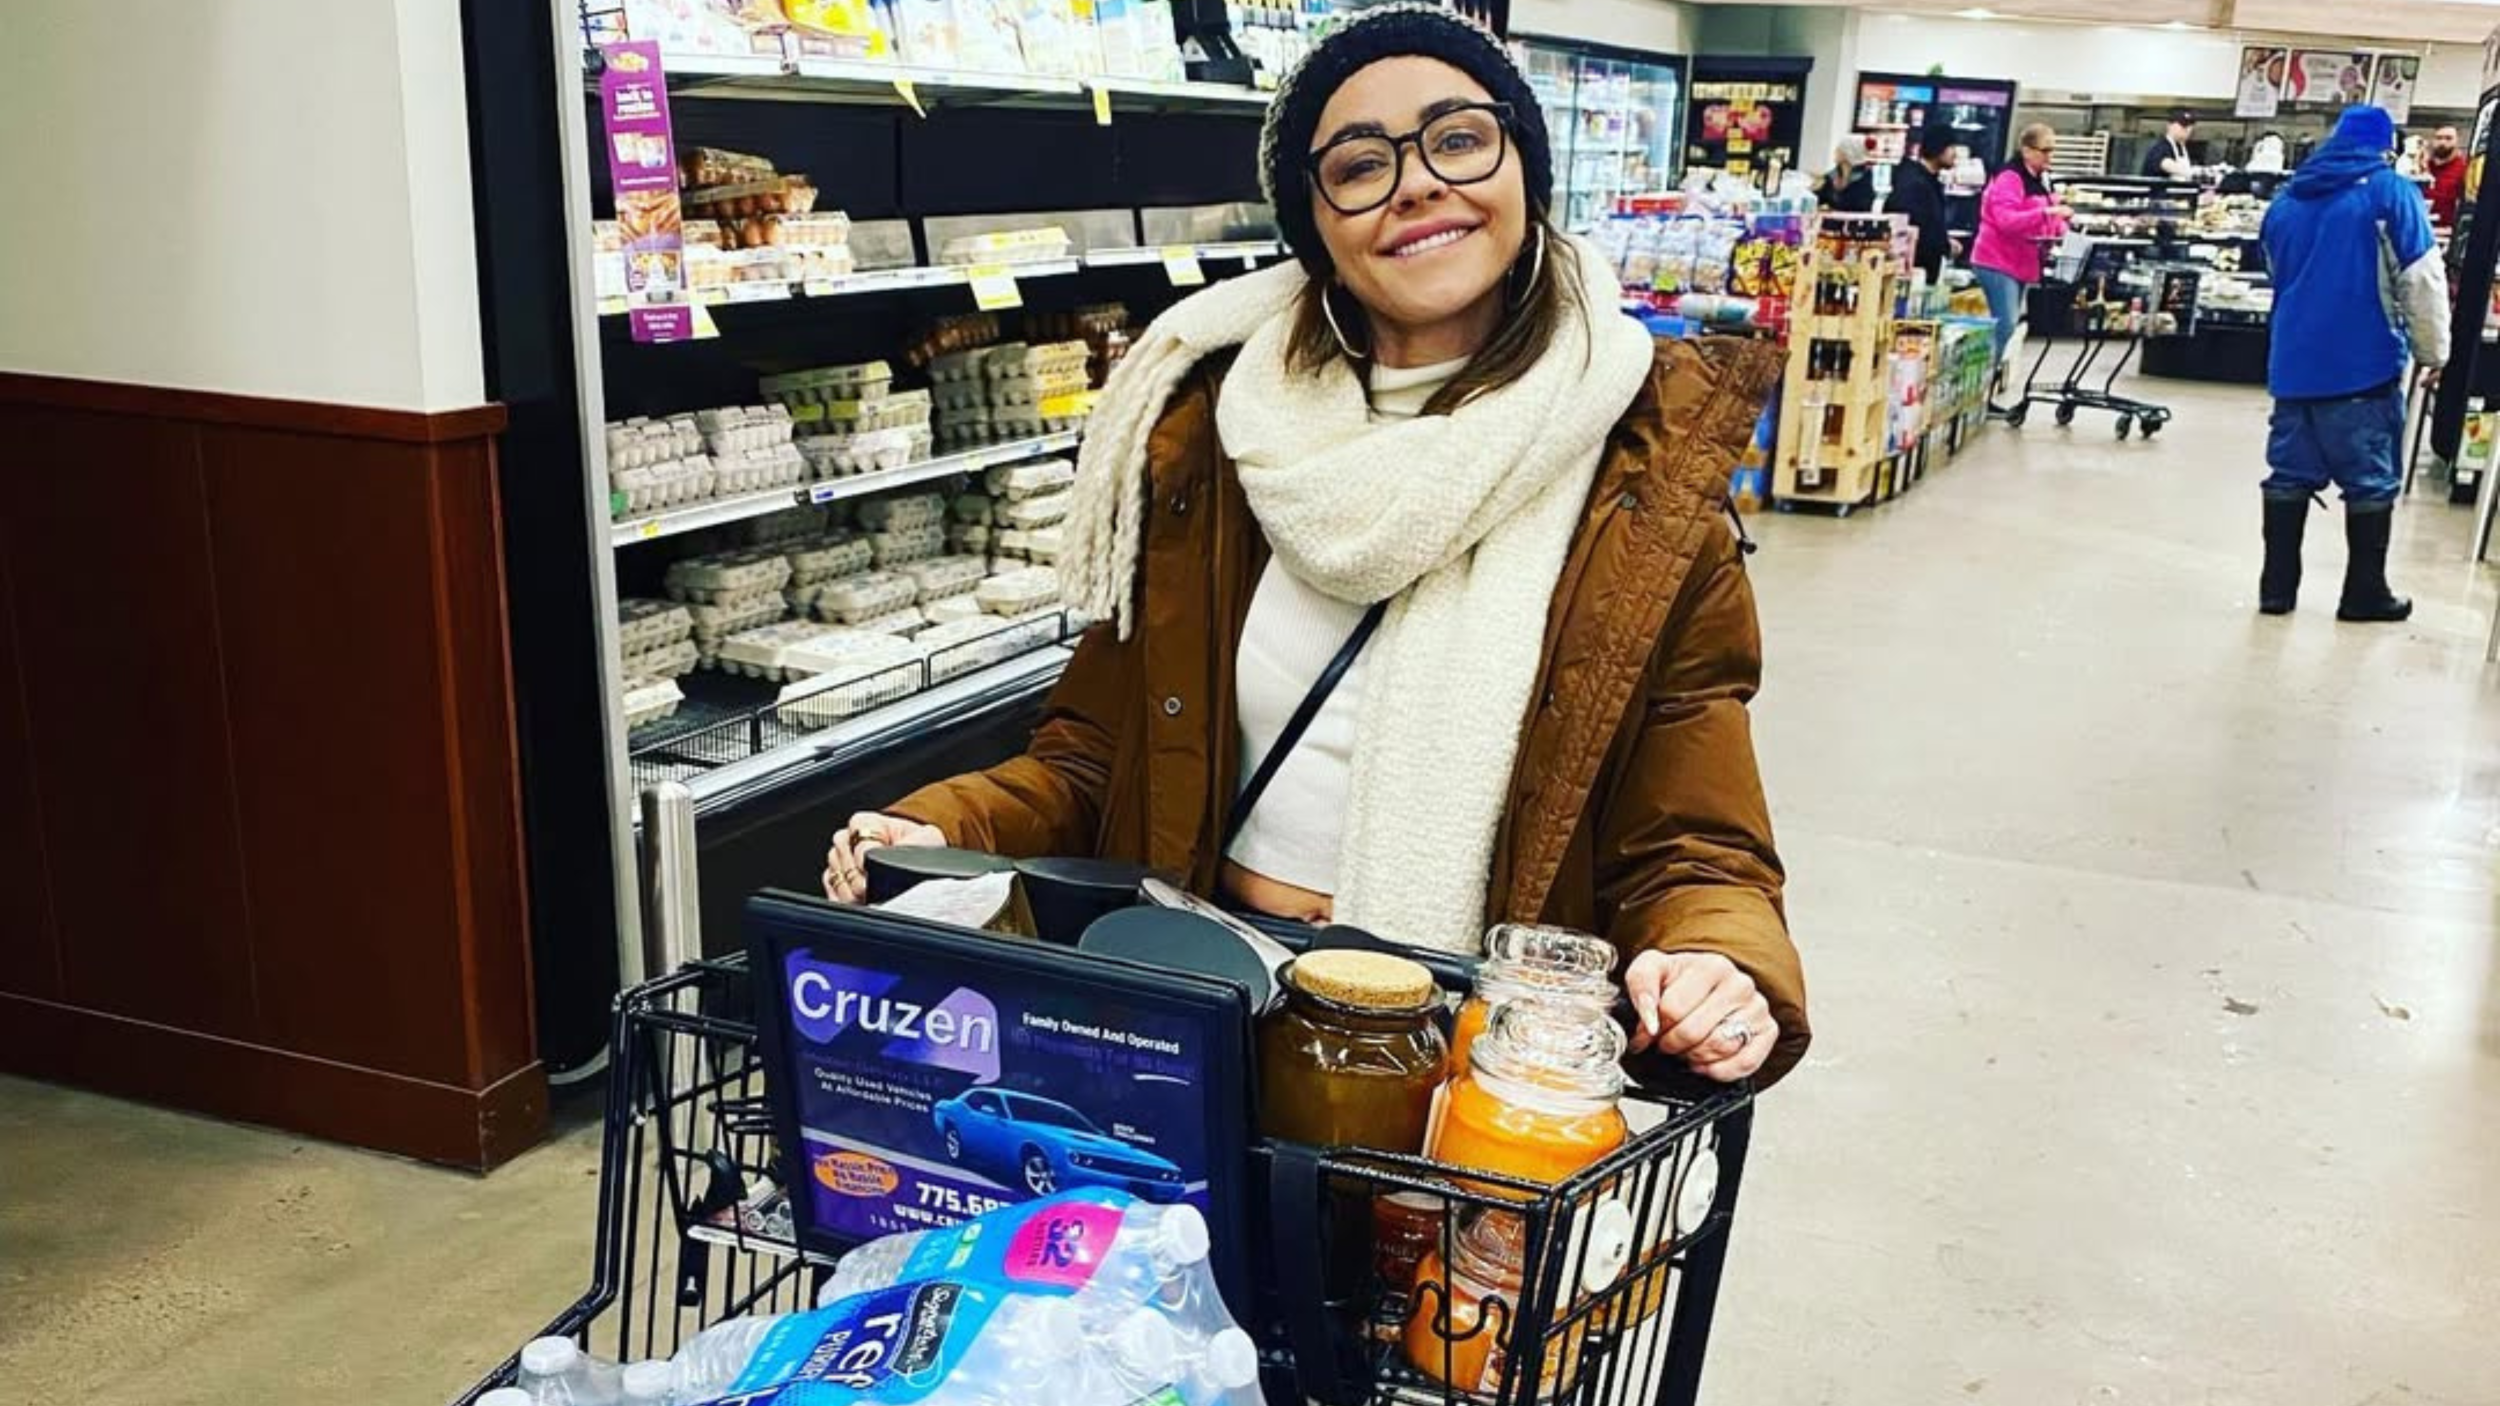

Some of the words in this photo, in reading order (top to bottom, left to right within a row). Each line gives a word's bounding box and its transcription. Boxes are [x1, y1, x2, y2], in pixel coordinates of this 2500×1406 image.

[793, 971, 992, 1053] Cruzen
[1023, 1012, 1059, 1031] Family
[1061, 1020, 1100, 1038] Owned
[1102, 1028, 1126, 1043] And
[1127, 1033, 1179, 1054] Operated
[814, 1067, 852, 1084] Quality
[855, 1076, 883, 1091] Used
[886, 1083, 932, 1101] Vehicles
[894, 1097, 929, 1113] Prices
[1040, 1218, 1083, 1268] 32
